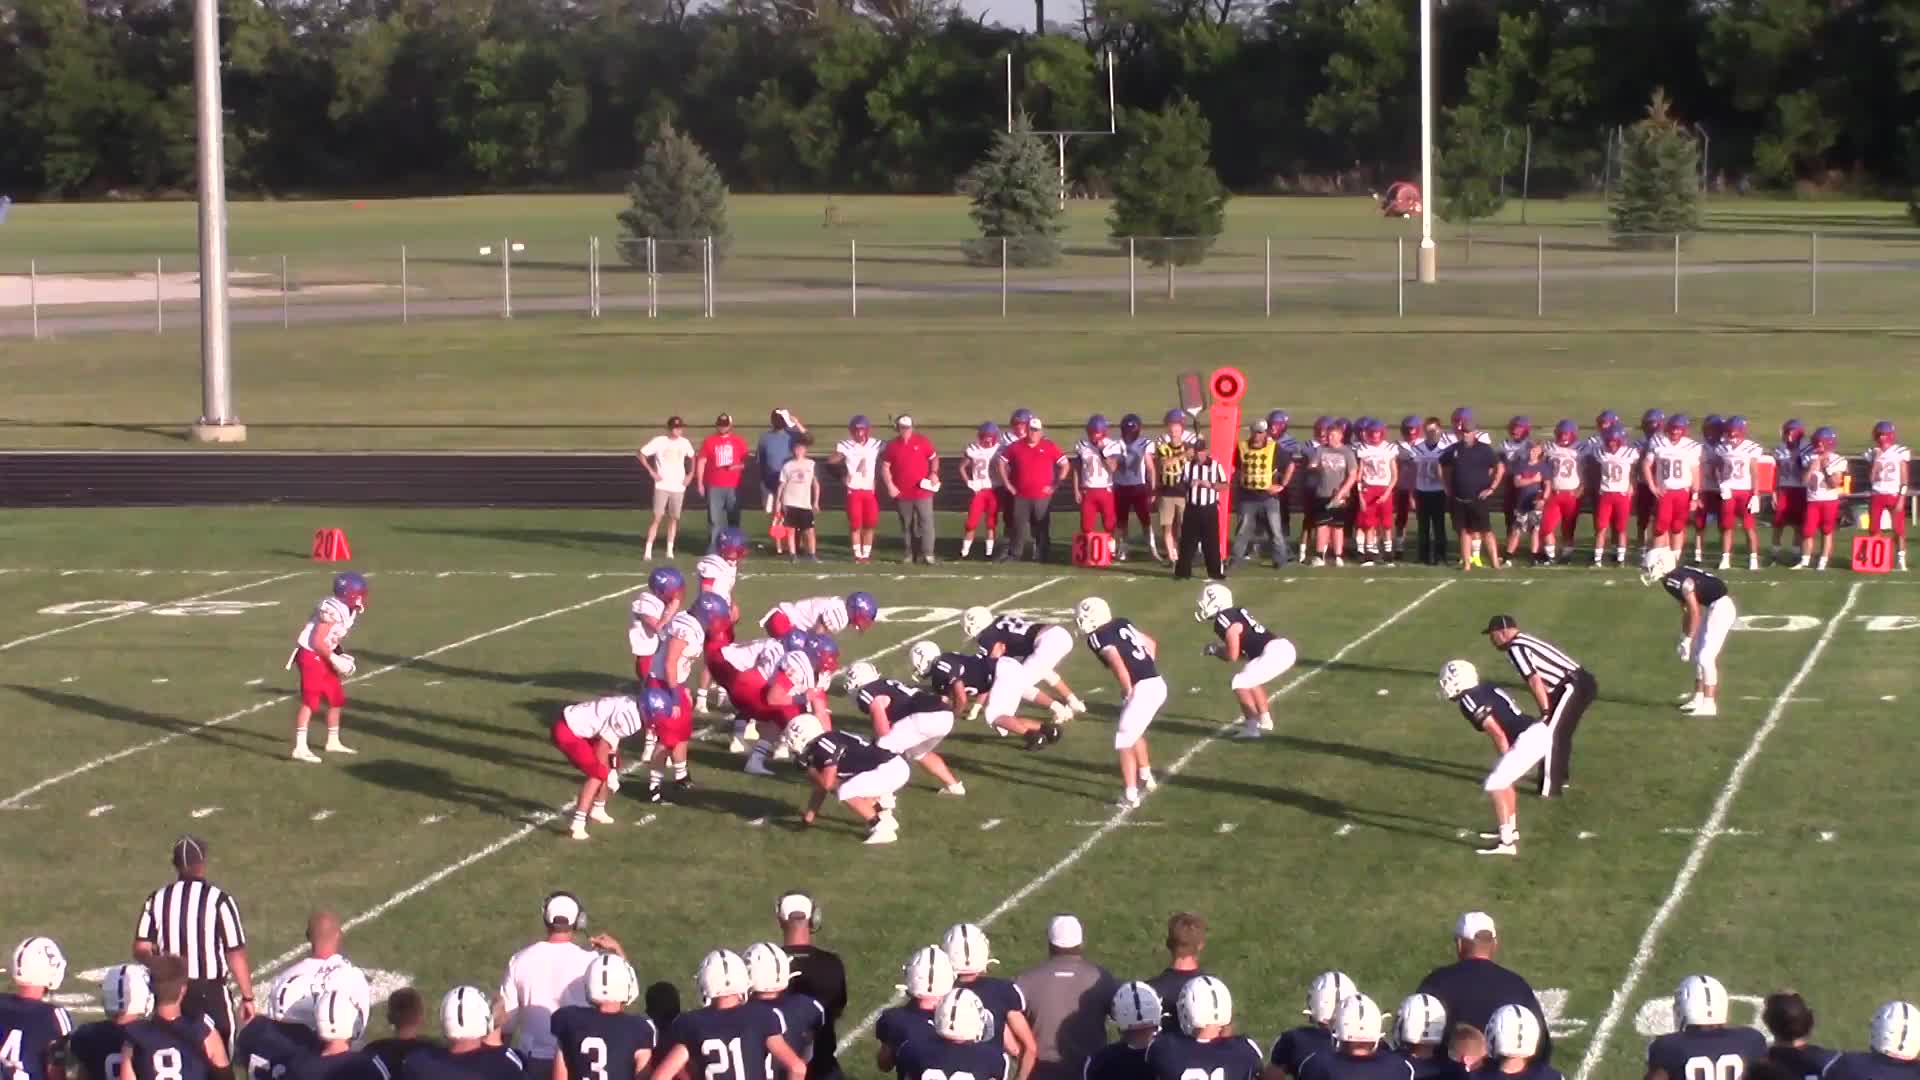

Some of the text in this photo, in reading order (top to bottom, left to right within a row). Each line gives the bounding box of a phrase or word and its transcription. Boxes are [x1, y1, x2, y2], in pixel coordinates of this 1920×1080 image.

[314, 530, 334, 559] 20
[1074, 533, 1103, 564] 30
[1855, 539, 1885, 568] 40
[152, 1047, 182, 1080] 8
[580, 1036, 609, 1080] 3
[701, 1037, 746, 1080] 21
